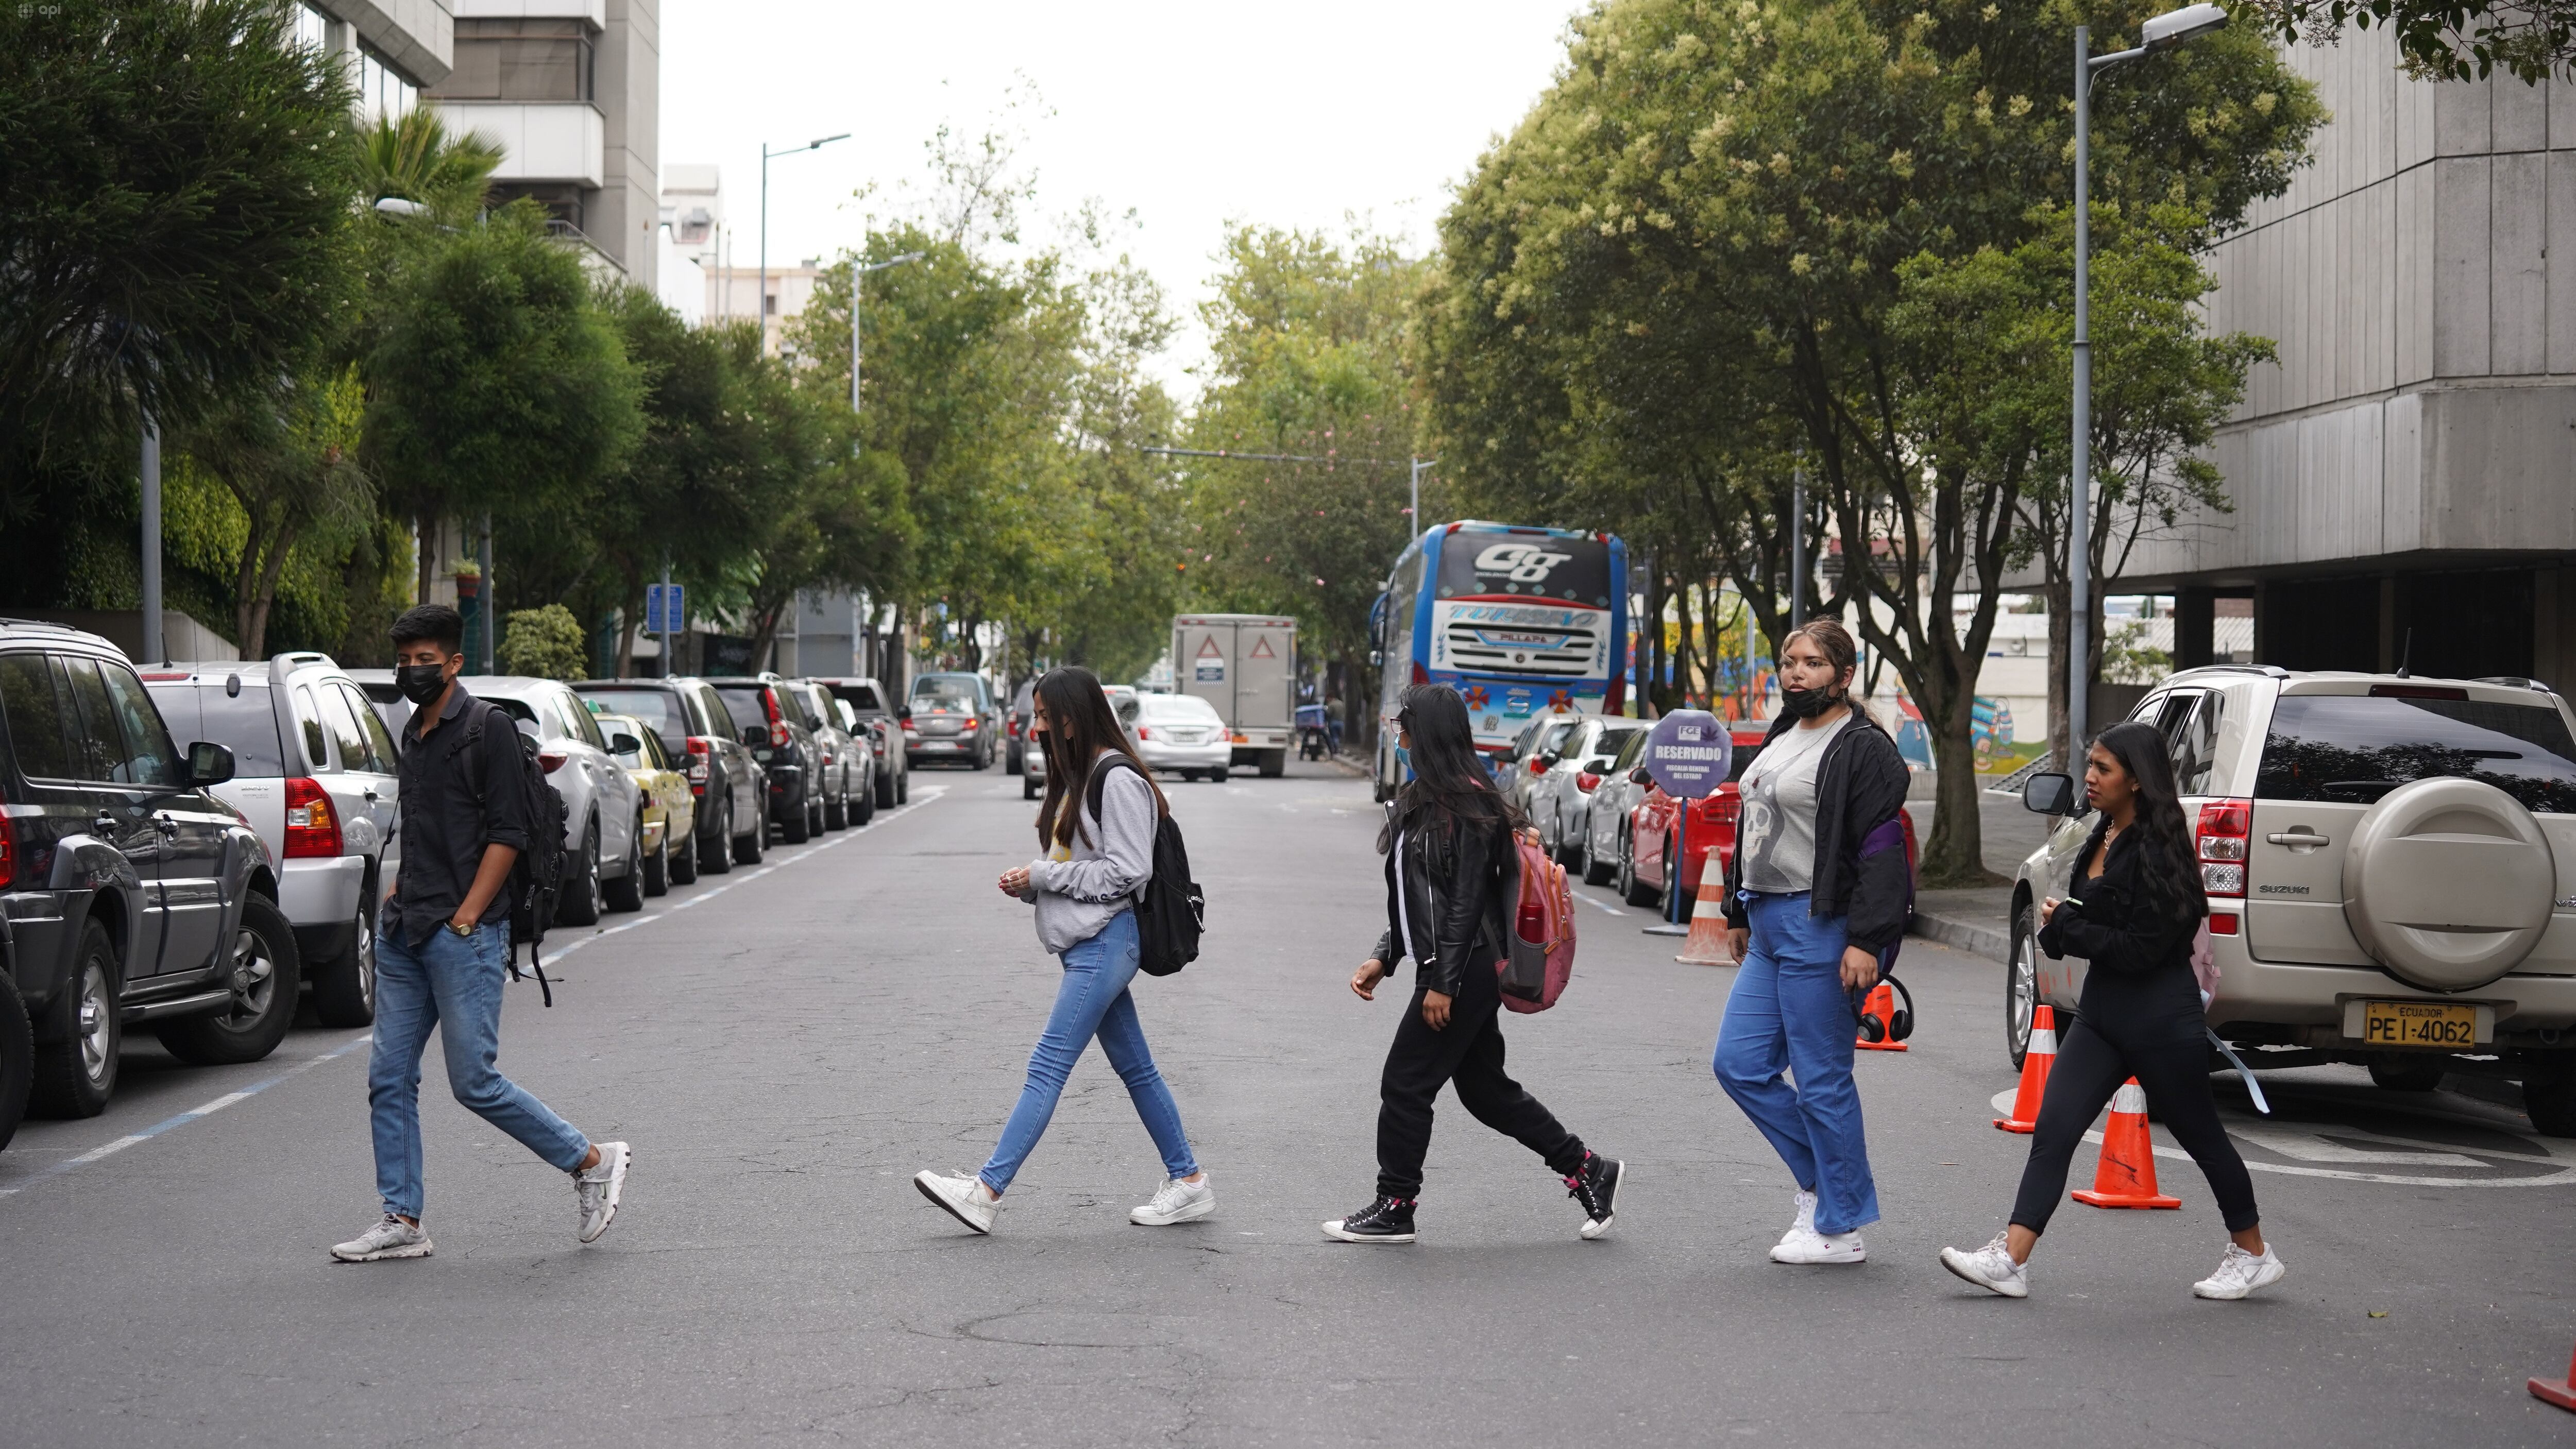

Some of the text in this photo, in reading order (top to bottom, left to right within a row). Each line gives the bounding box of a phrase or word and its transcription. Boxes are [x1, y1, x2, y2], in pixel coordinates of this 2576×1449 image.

[1500, 634, 1548, 642] PILLAPA
[1680, 726, 1700, 735] FGE
[1656, 745, 1722, 761] RESERVADO
[2259, 884, 2309, 894] SUZUKI
[2400, 1007, 2443, 1018] ECUADOR
